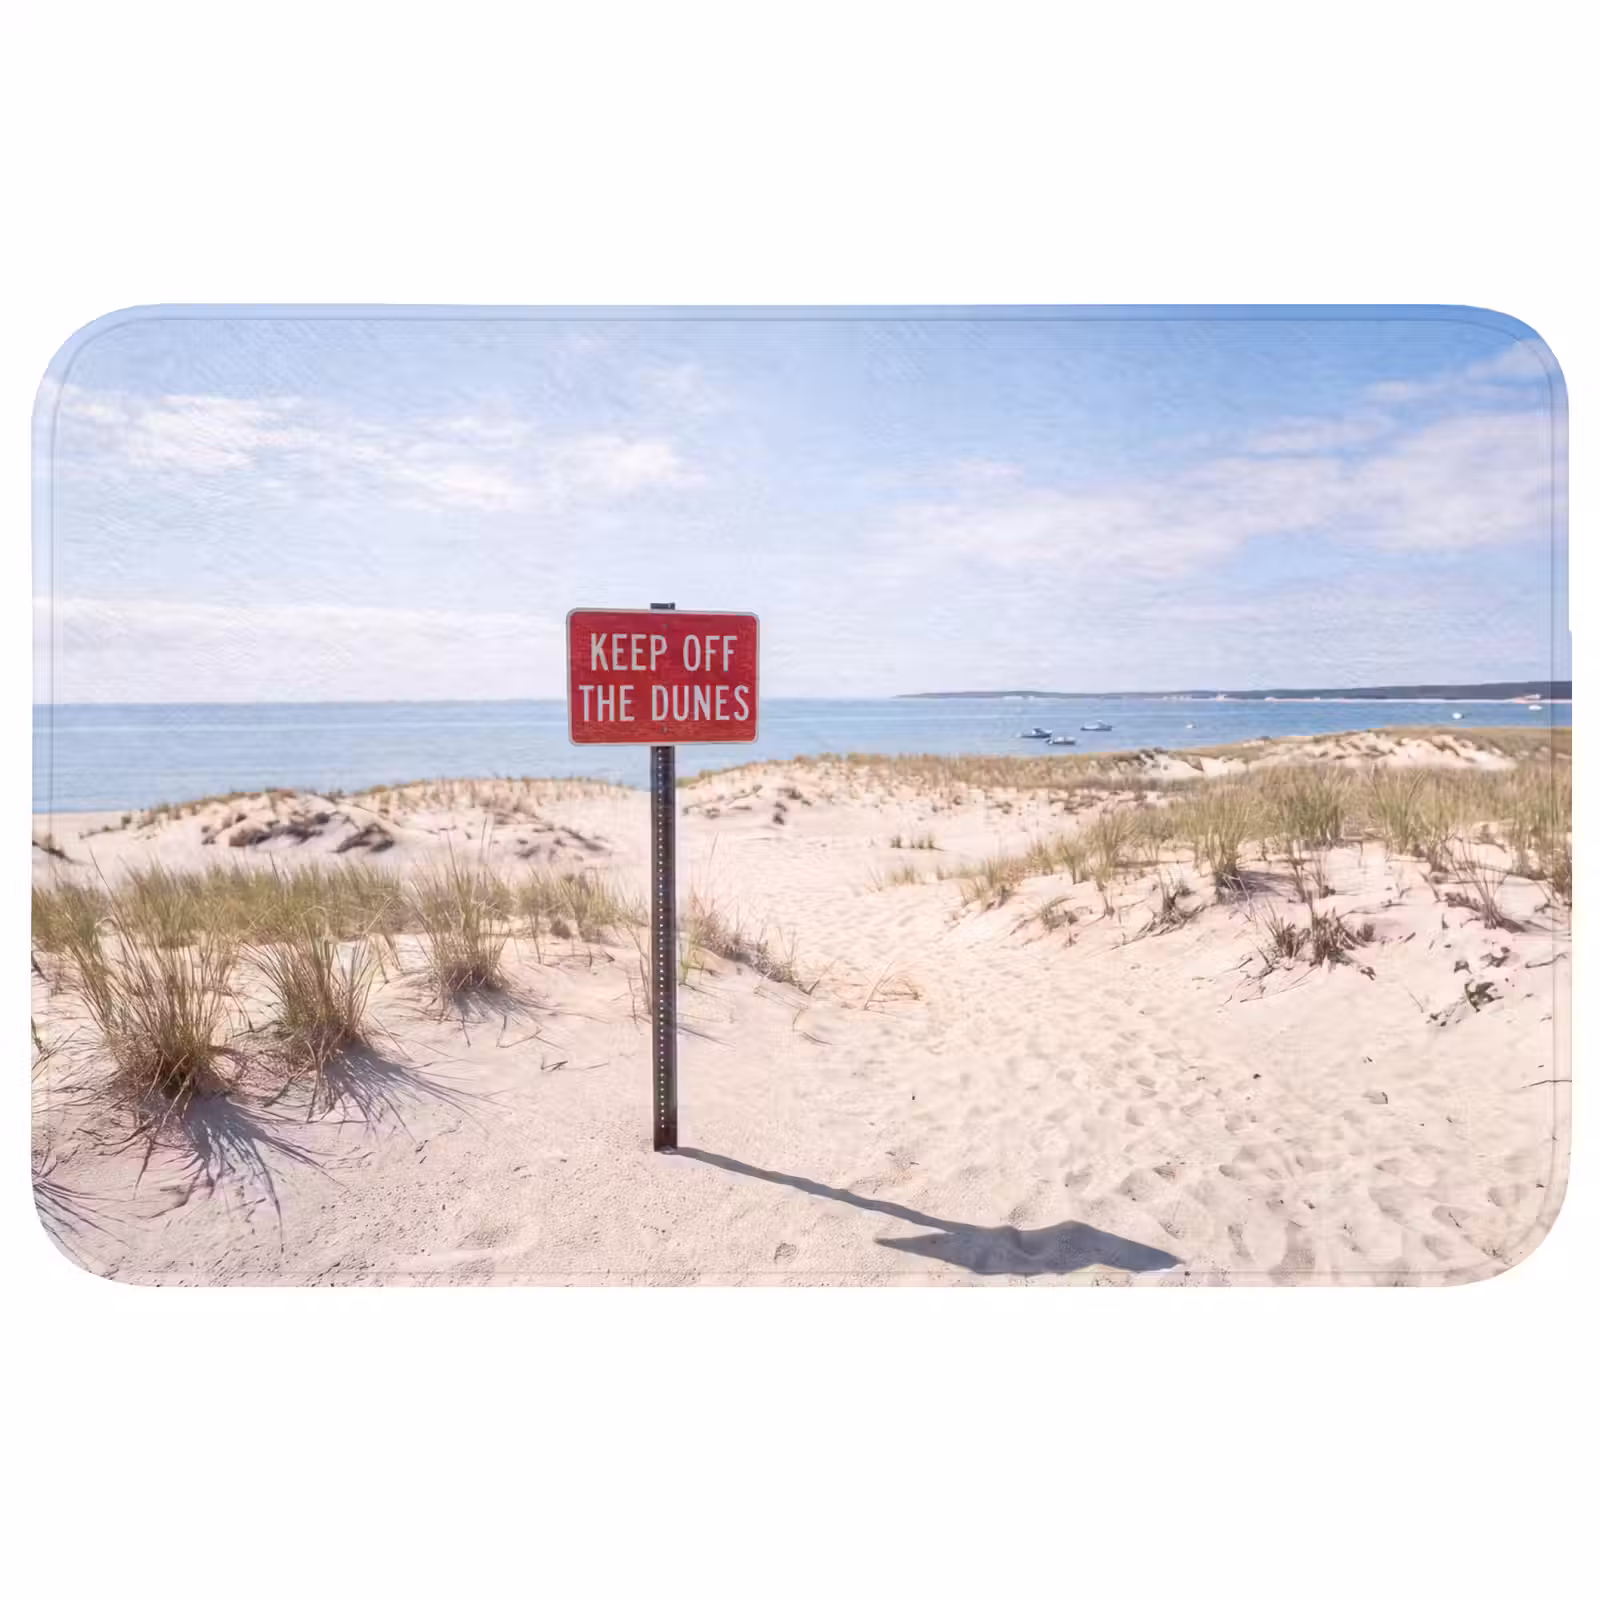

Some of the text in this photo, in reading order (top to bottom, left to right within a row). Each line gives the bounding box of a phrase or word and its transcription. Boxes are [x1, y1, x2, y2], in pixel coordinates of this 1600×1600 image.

[591, 633, 738, 672] KEEP OFF
[579, 684, 750, 722] THE DUNES
